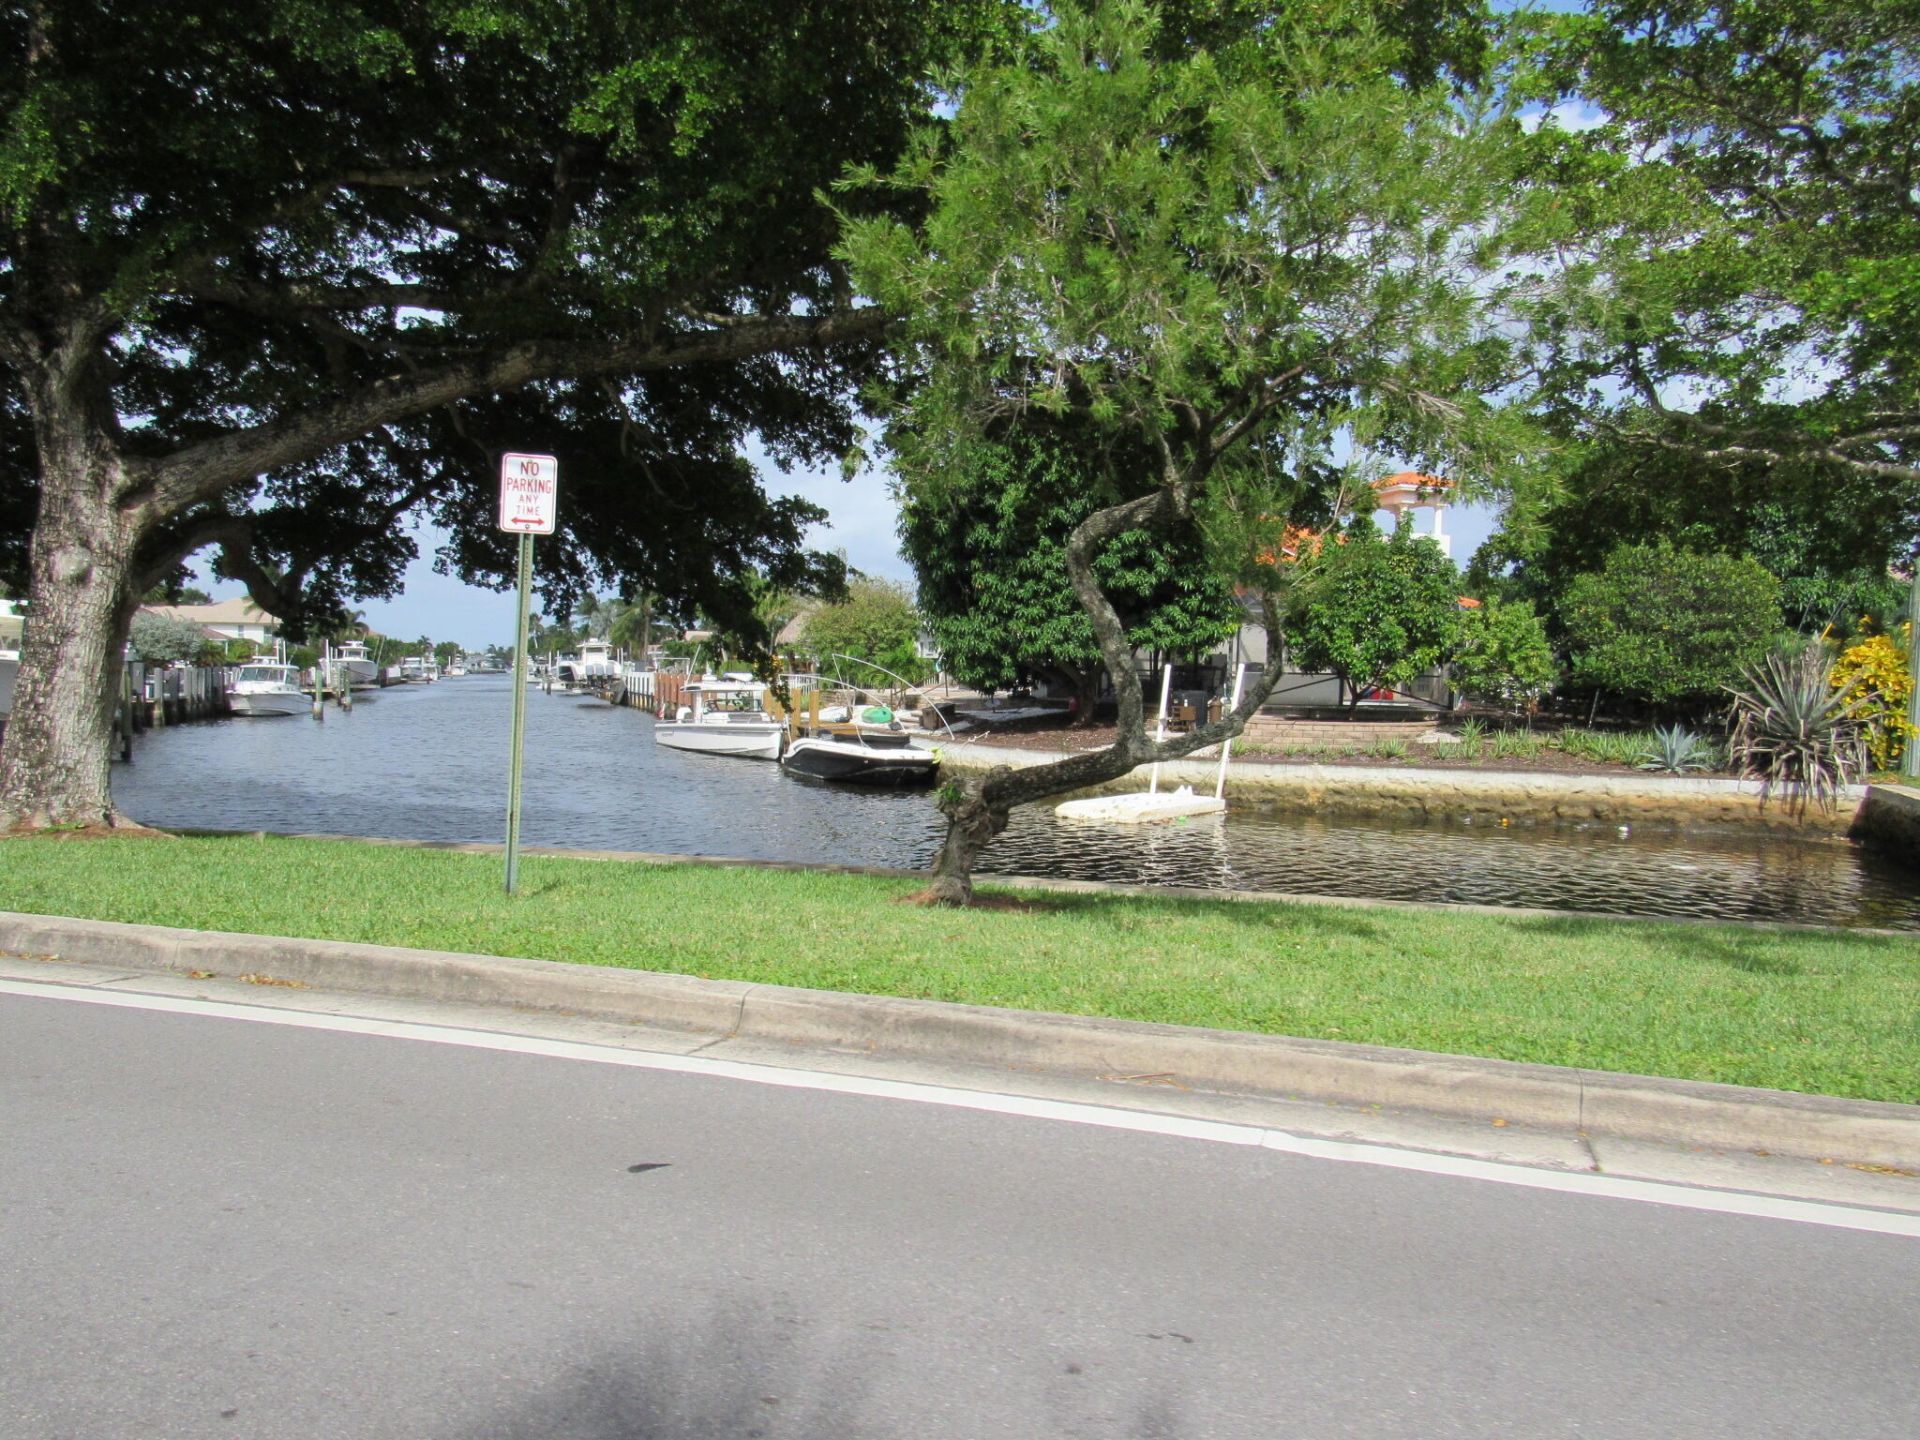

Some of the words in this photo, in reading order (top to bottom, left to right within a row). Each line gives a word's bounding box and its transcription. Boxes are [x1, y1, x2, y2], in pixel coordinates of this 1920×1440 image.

[520, 461, 540, 476] NO
[506, 477, 552, 494] PARKING
[519, 494, 539, 504] ANY
[516, 504, 541, 516] TIME
